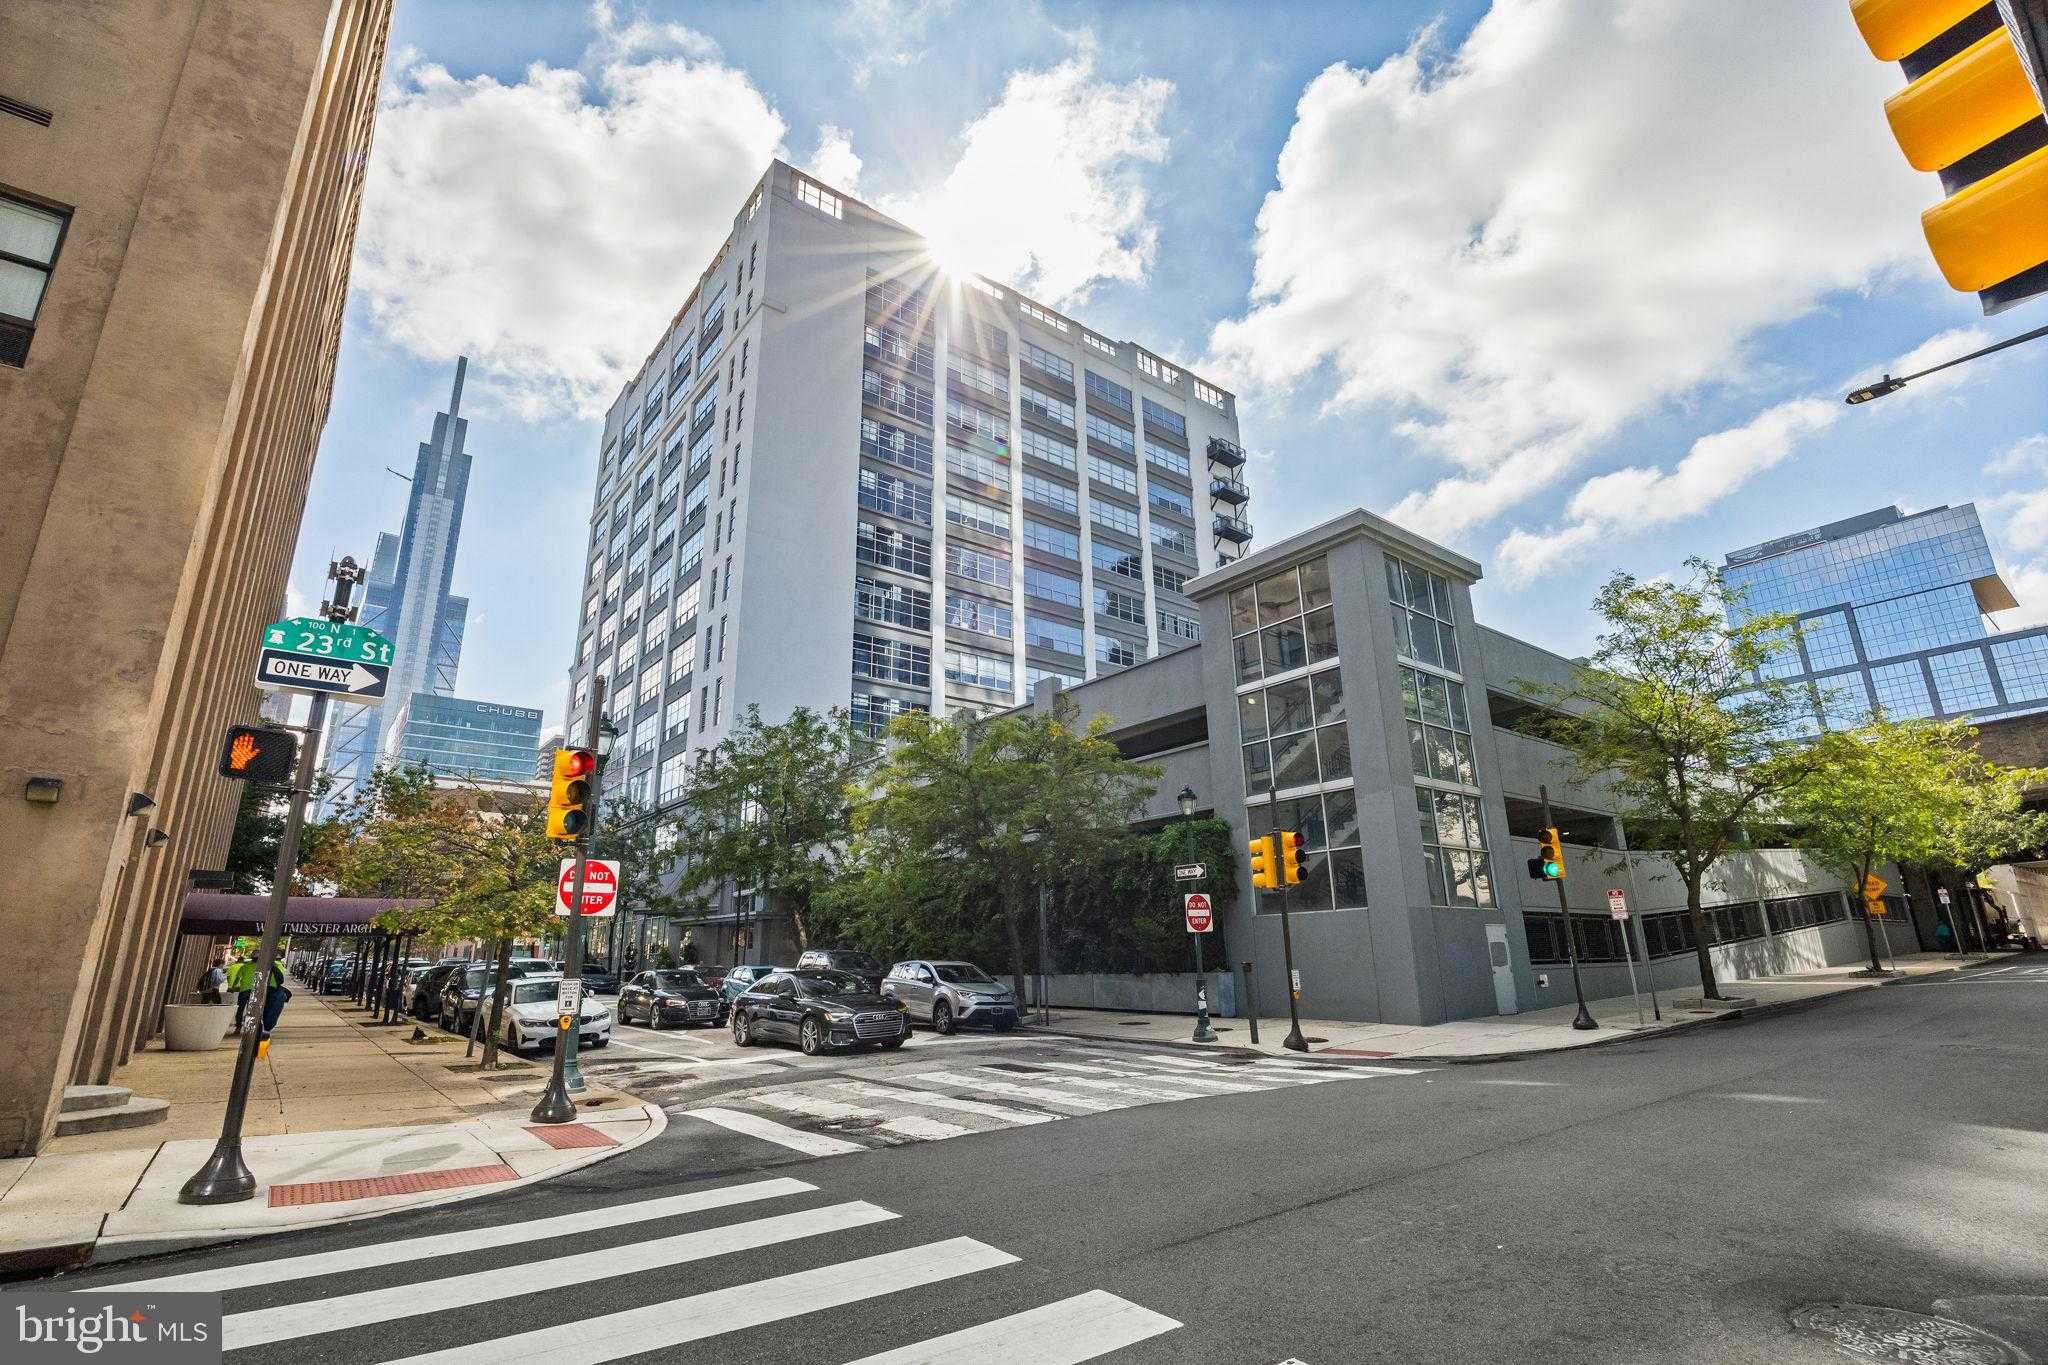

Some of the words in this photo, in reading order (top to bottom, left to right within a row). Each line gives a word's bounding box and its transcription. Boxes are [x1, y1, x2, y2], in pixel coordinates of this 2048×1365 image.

[309, 621, 326, 631] 100
[330, 624, 341, 634] N
[296, 632, 352, 654] 23rd
[360, 641, 391, 663] St
[274, 661, 312, 678] ONE
[318, 666, 351, 683] WAY
[476, 704, 538, 719] CHUBB
[590, 871, 610, 880] NOT
[571, 895, 604, 905] TER
[1191, 917, 1207, 925] ENTER
[256, 922, 340, 934] WTMINSTER
